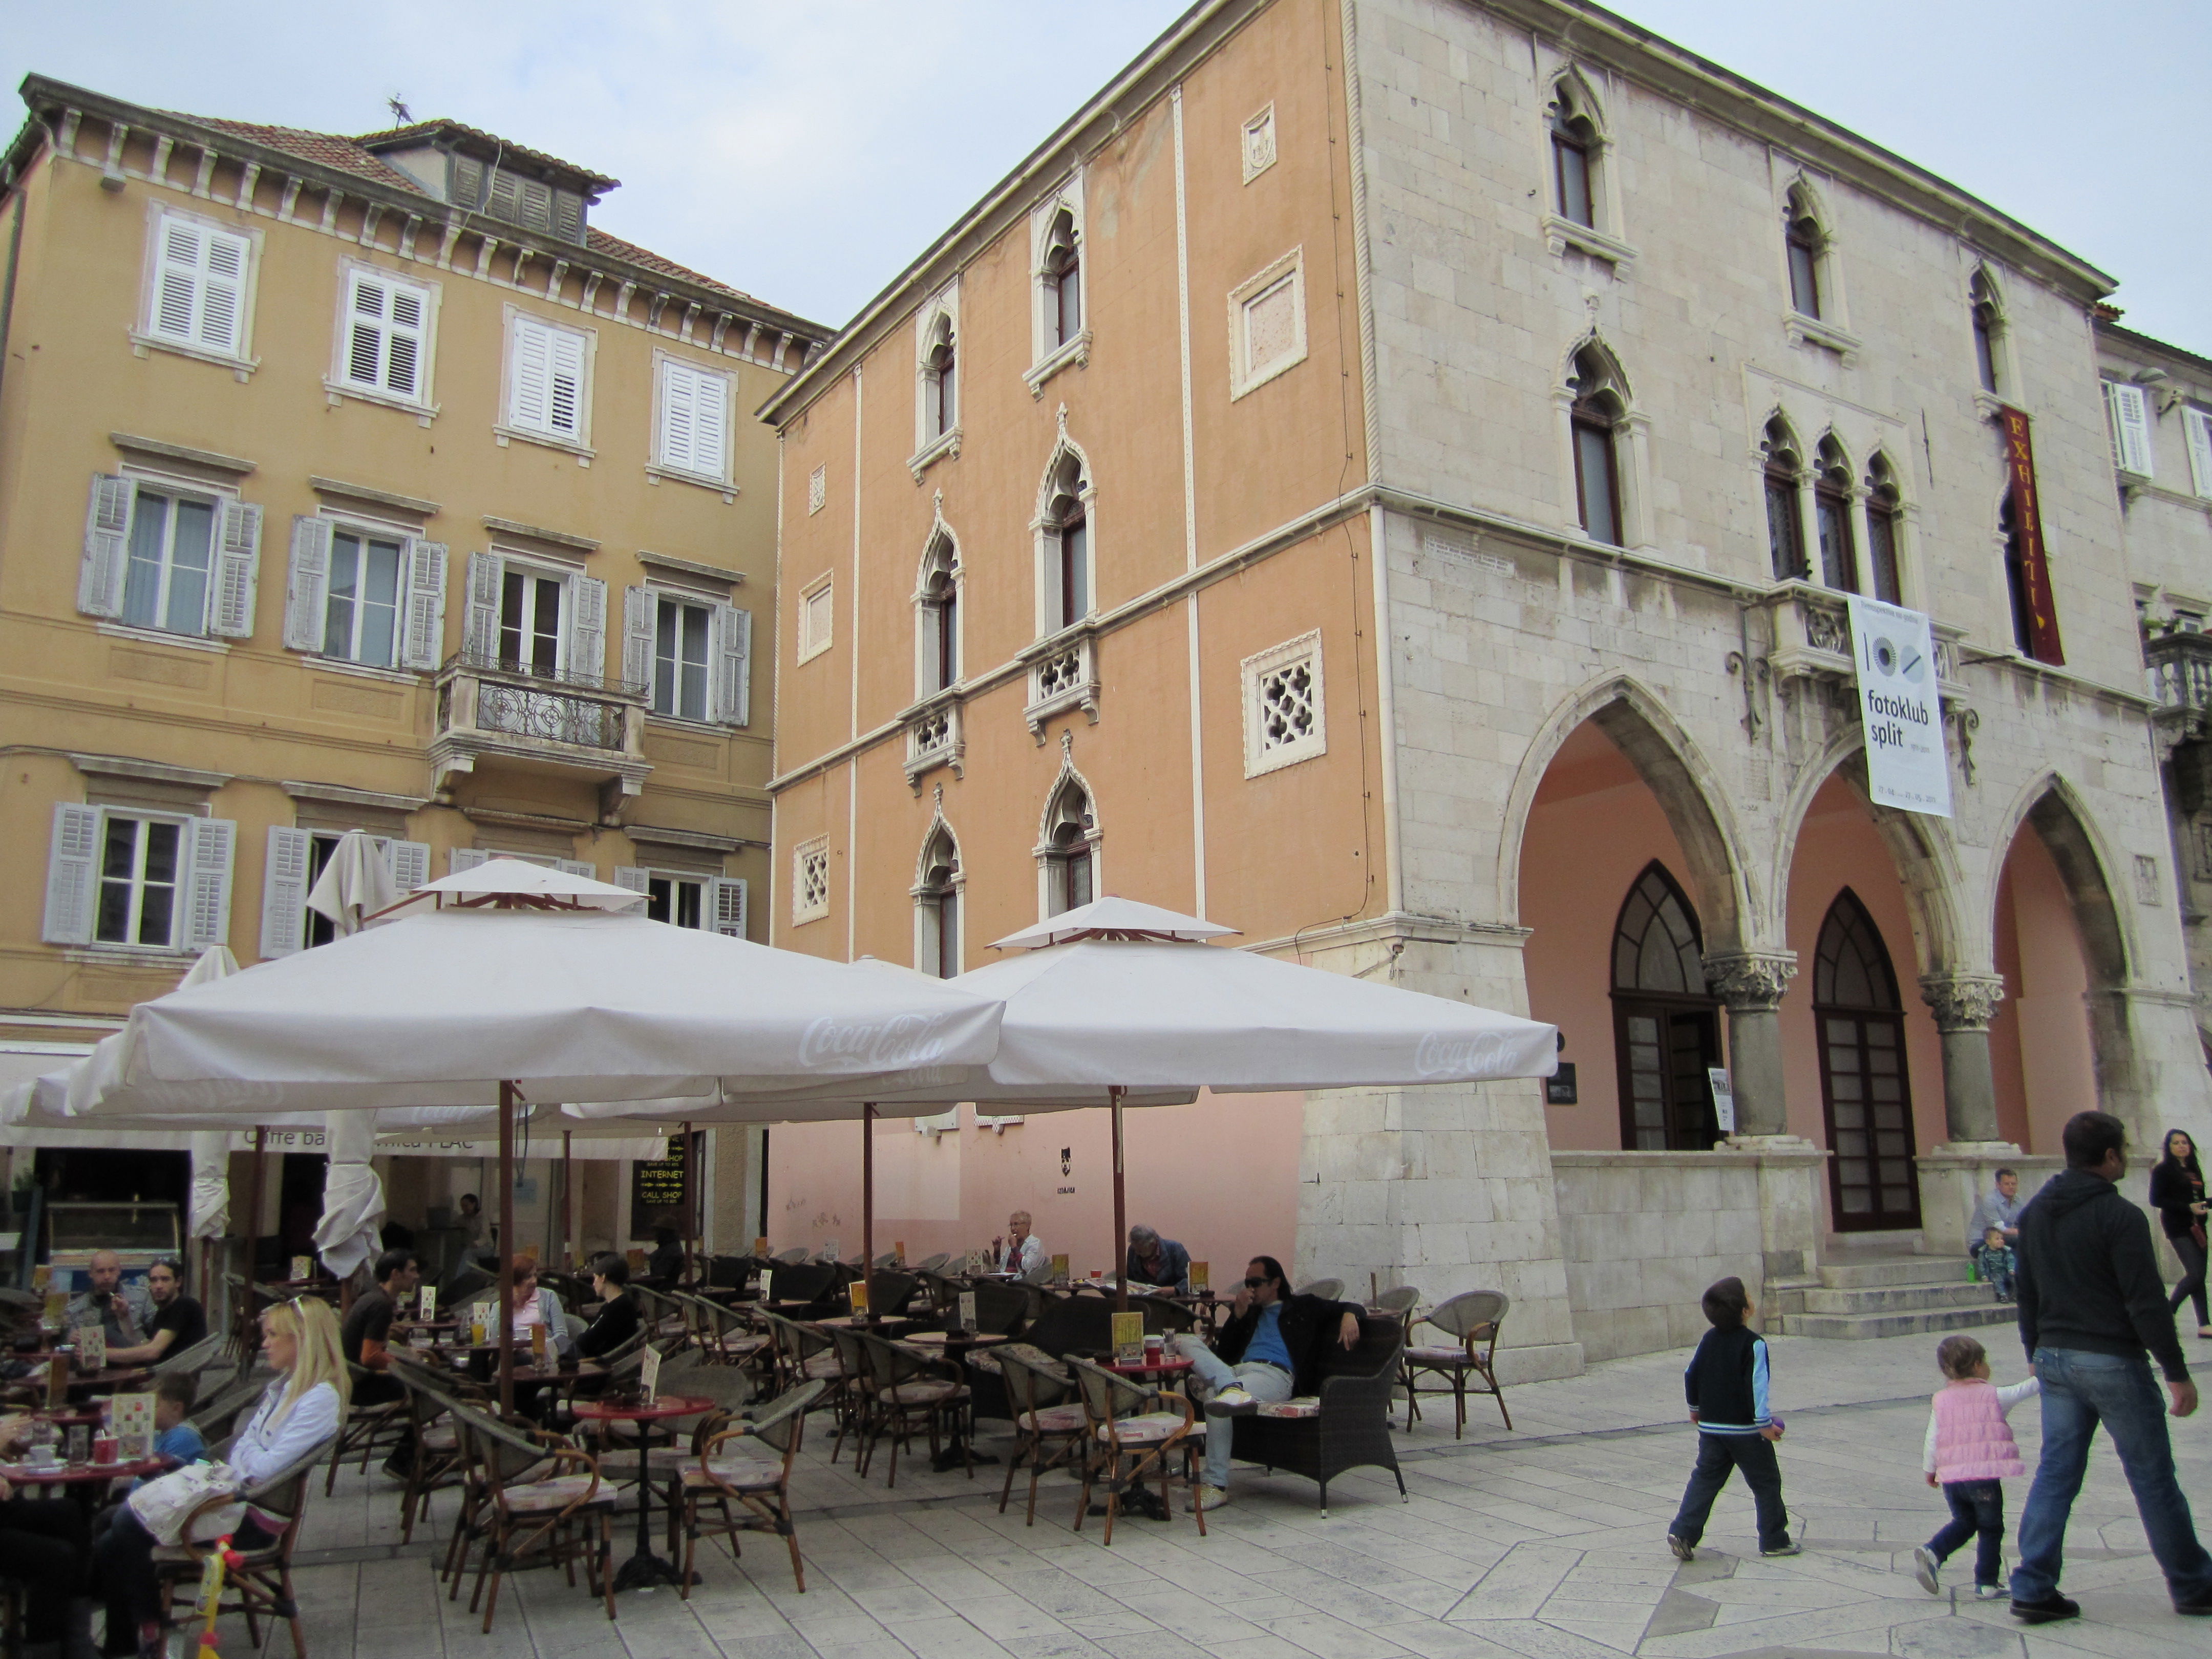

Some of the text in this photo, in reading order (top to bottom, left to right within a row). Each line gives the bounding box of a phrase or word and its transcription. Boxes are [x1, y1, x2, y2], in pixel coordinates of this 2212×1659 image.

[1868, 689, 1929, 726] fotoklub
[1871, 721, 1903, 750] split
[303, 1131, 325, 1145] ba
[641, 1171, 684, 1179] INTERNET
